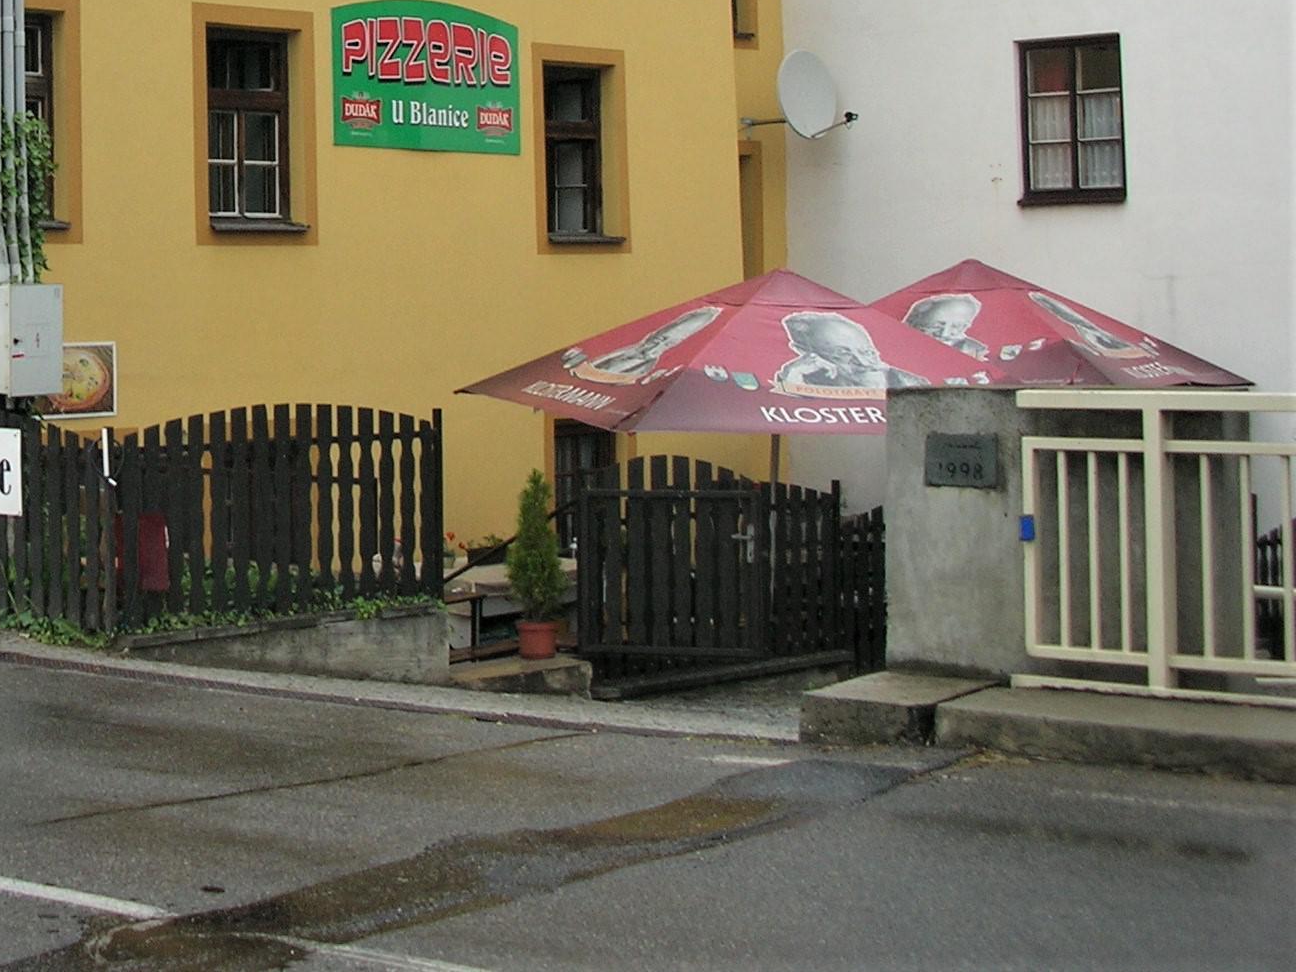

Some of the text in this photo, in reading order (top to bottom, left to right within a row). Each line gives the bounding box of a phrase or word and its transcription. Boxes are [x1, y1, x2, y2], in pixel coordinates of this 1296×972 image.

[344, 102, 378, 120] DUDÁK
[410, 100, 469, 128] Blanice
[479, 111, 509, 127] DUDÁK
[938, 462, 984, 481] 1998
